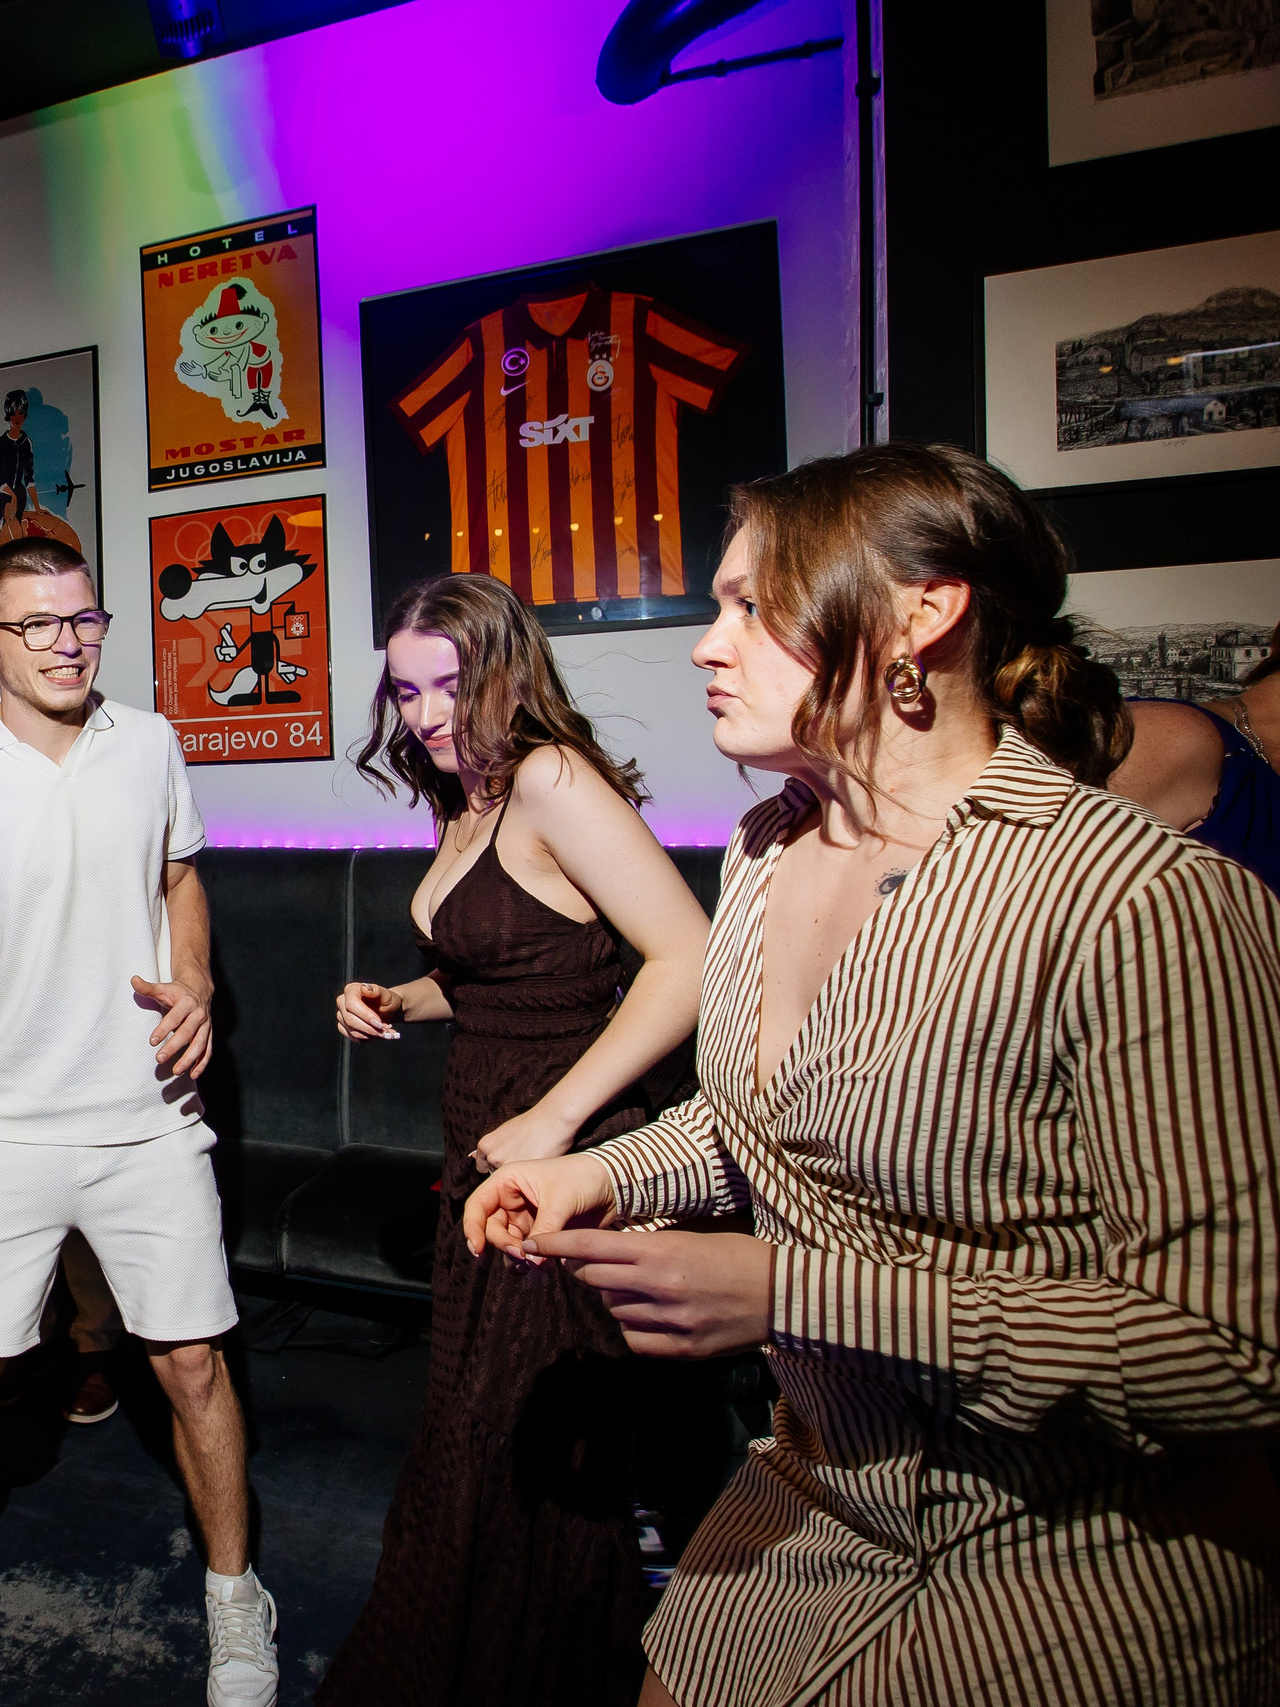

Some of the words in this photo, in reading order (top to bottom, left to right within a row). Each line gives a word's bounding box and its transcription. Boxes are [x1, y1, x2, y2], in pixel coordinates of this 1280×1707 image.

[157, 224, 298, 265] HOTEL
[158, 244, 298, 289] NERETVA
[165, 429, 306, 461] MOSTAR
[166, 450, 307, 480] JUGOSLAVIJA
